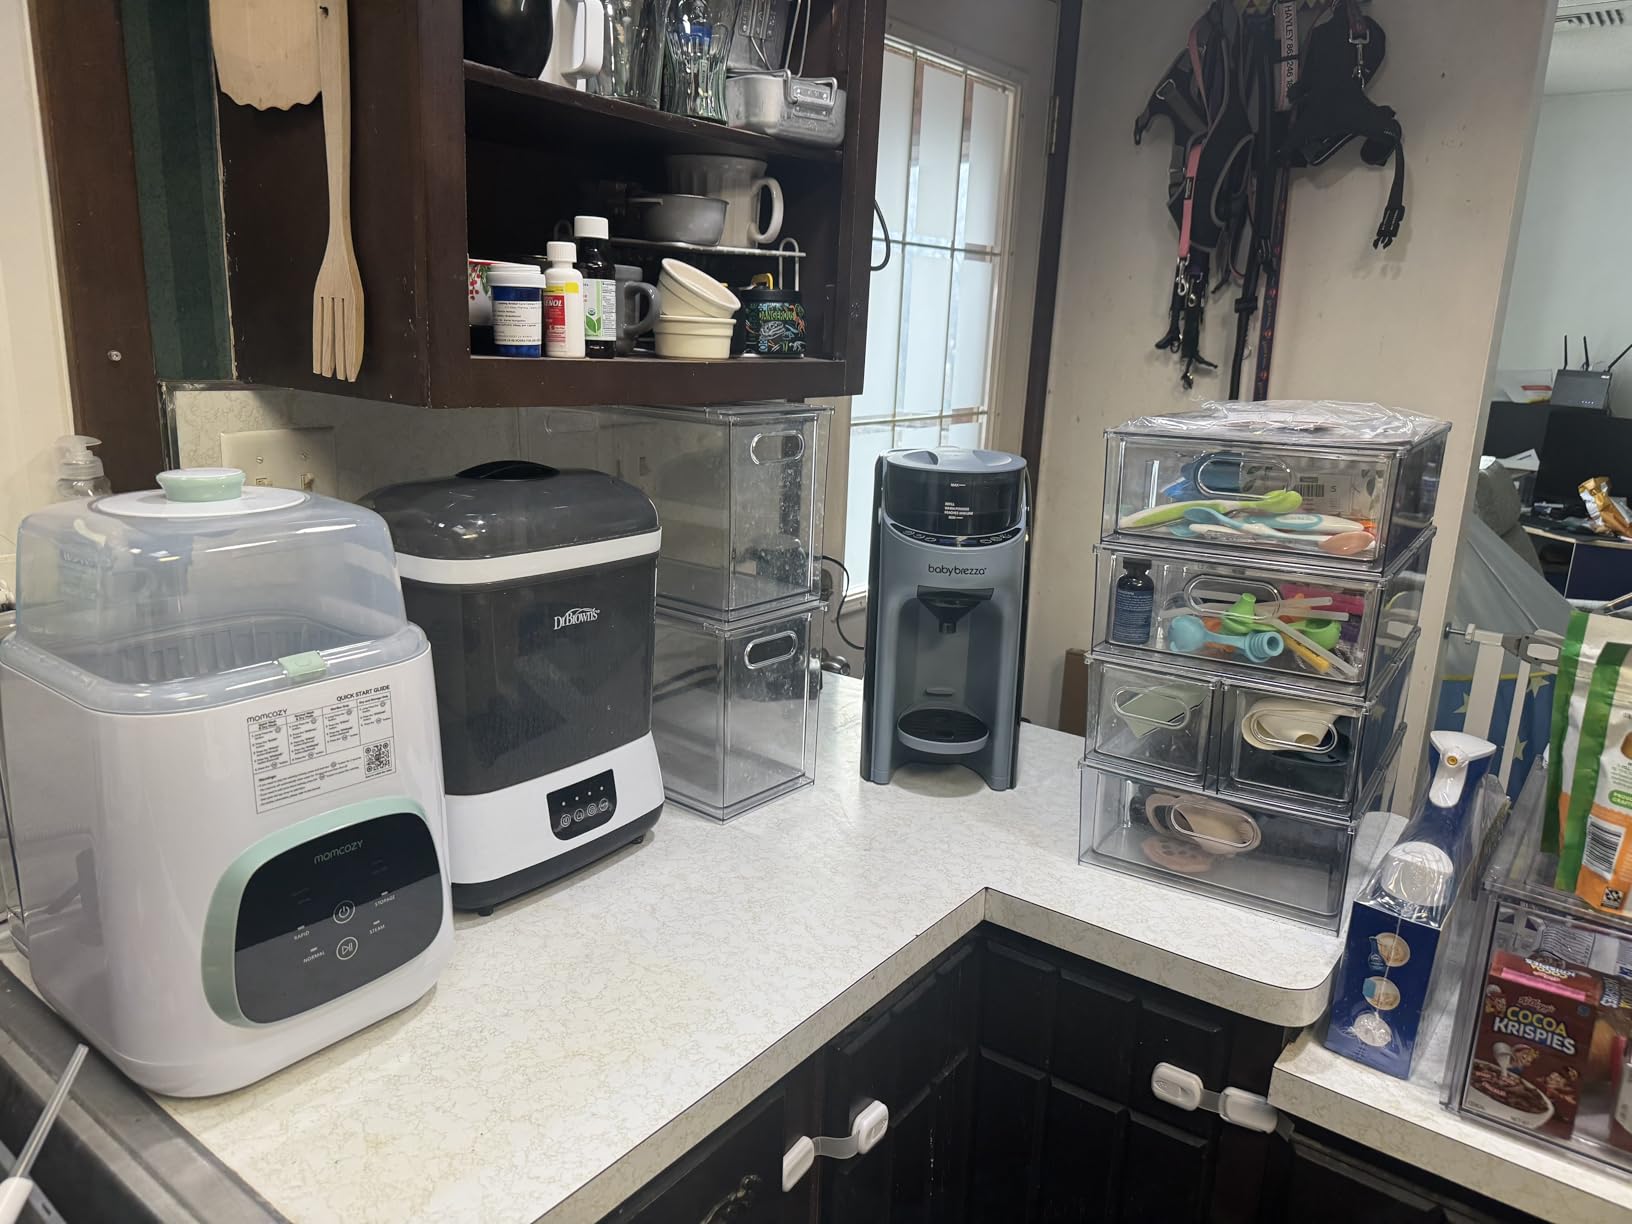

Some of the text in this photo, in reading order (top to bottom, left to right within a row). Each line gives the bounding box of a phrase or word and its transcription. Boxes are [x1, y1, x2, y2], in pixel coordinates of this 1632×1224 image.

[1284, 5, 1294, 41] HAYLEY
[336, 684, 390, 702] QUICK START GUIDE
[374, 894, 396, 907] STORAGE
[293, 930, 310, 940] RAPID
[369, 924, 385, 935] STEAM
[303, 950, 325, 963] NORMAL
[1507, 1006, 1567, 1037] COCOA
[1493, 1017, 1576, 1055] KRISPIES
